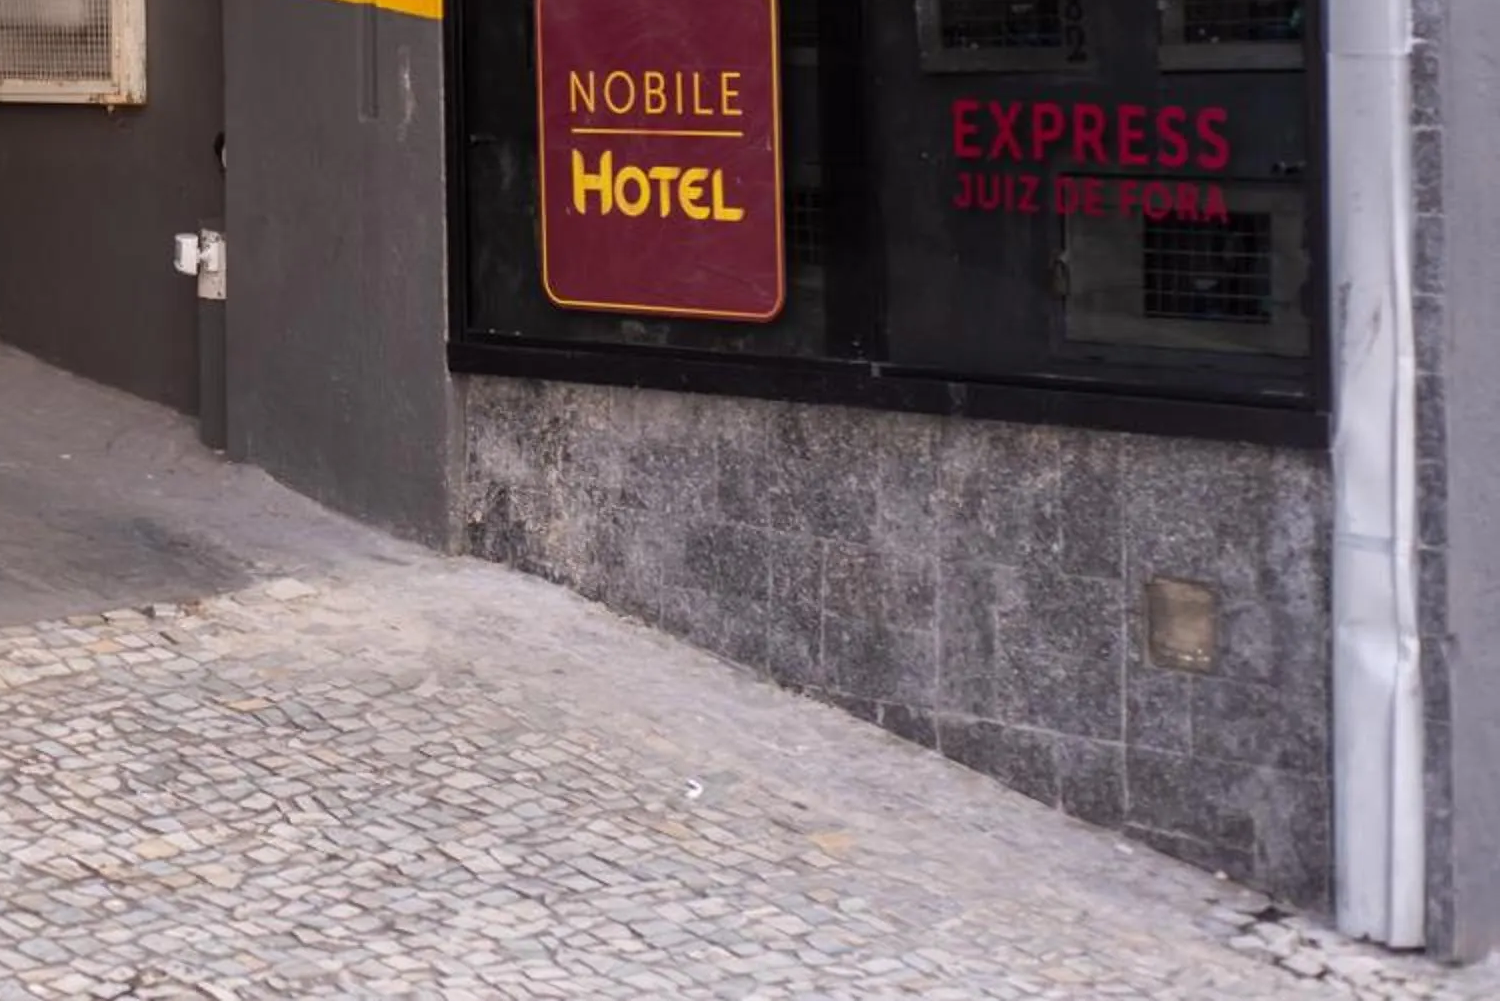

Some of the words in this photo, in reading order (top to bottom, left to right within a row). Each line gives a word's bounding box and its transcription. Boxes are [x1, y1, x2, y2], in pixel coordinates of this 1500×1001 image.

[570, 70, 743, 116] NOBILE
[953, 100, 1230, 169] EXPRESS
[572, 148, 745, 221] HOTEL
[954, 173, 1040, 214] JUIZ
[1055, 176, 1105, 217] DE
[1119, 181, 1230, 223] FORA
